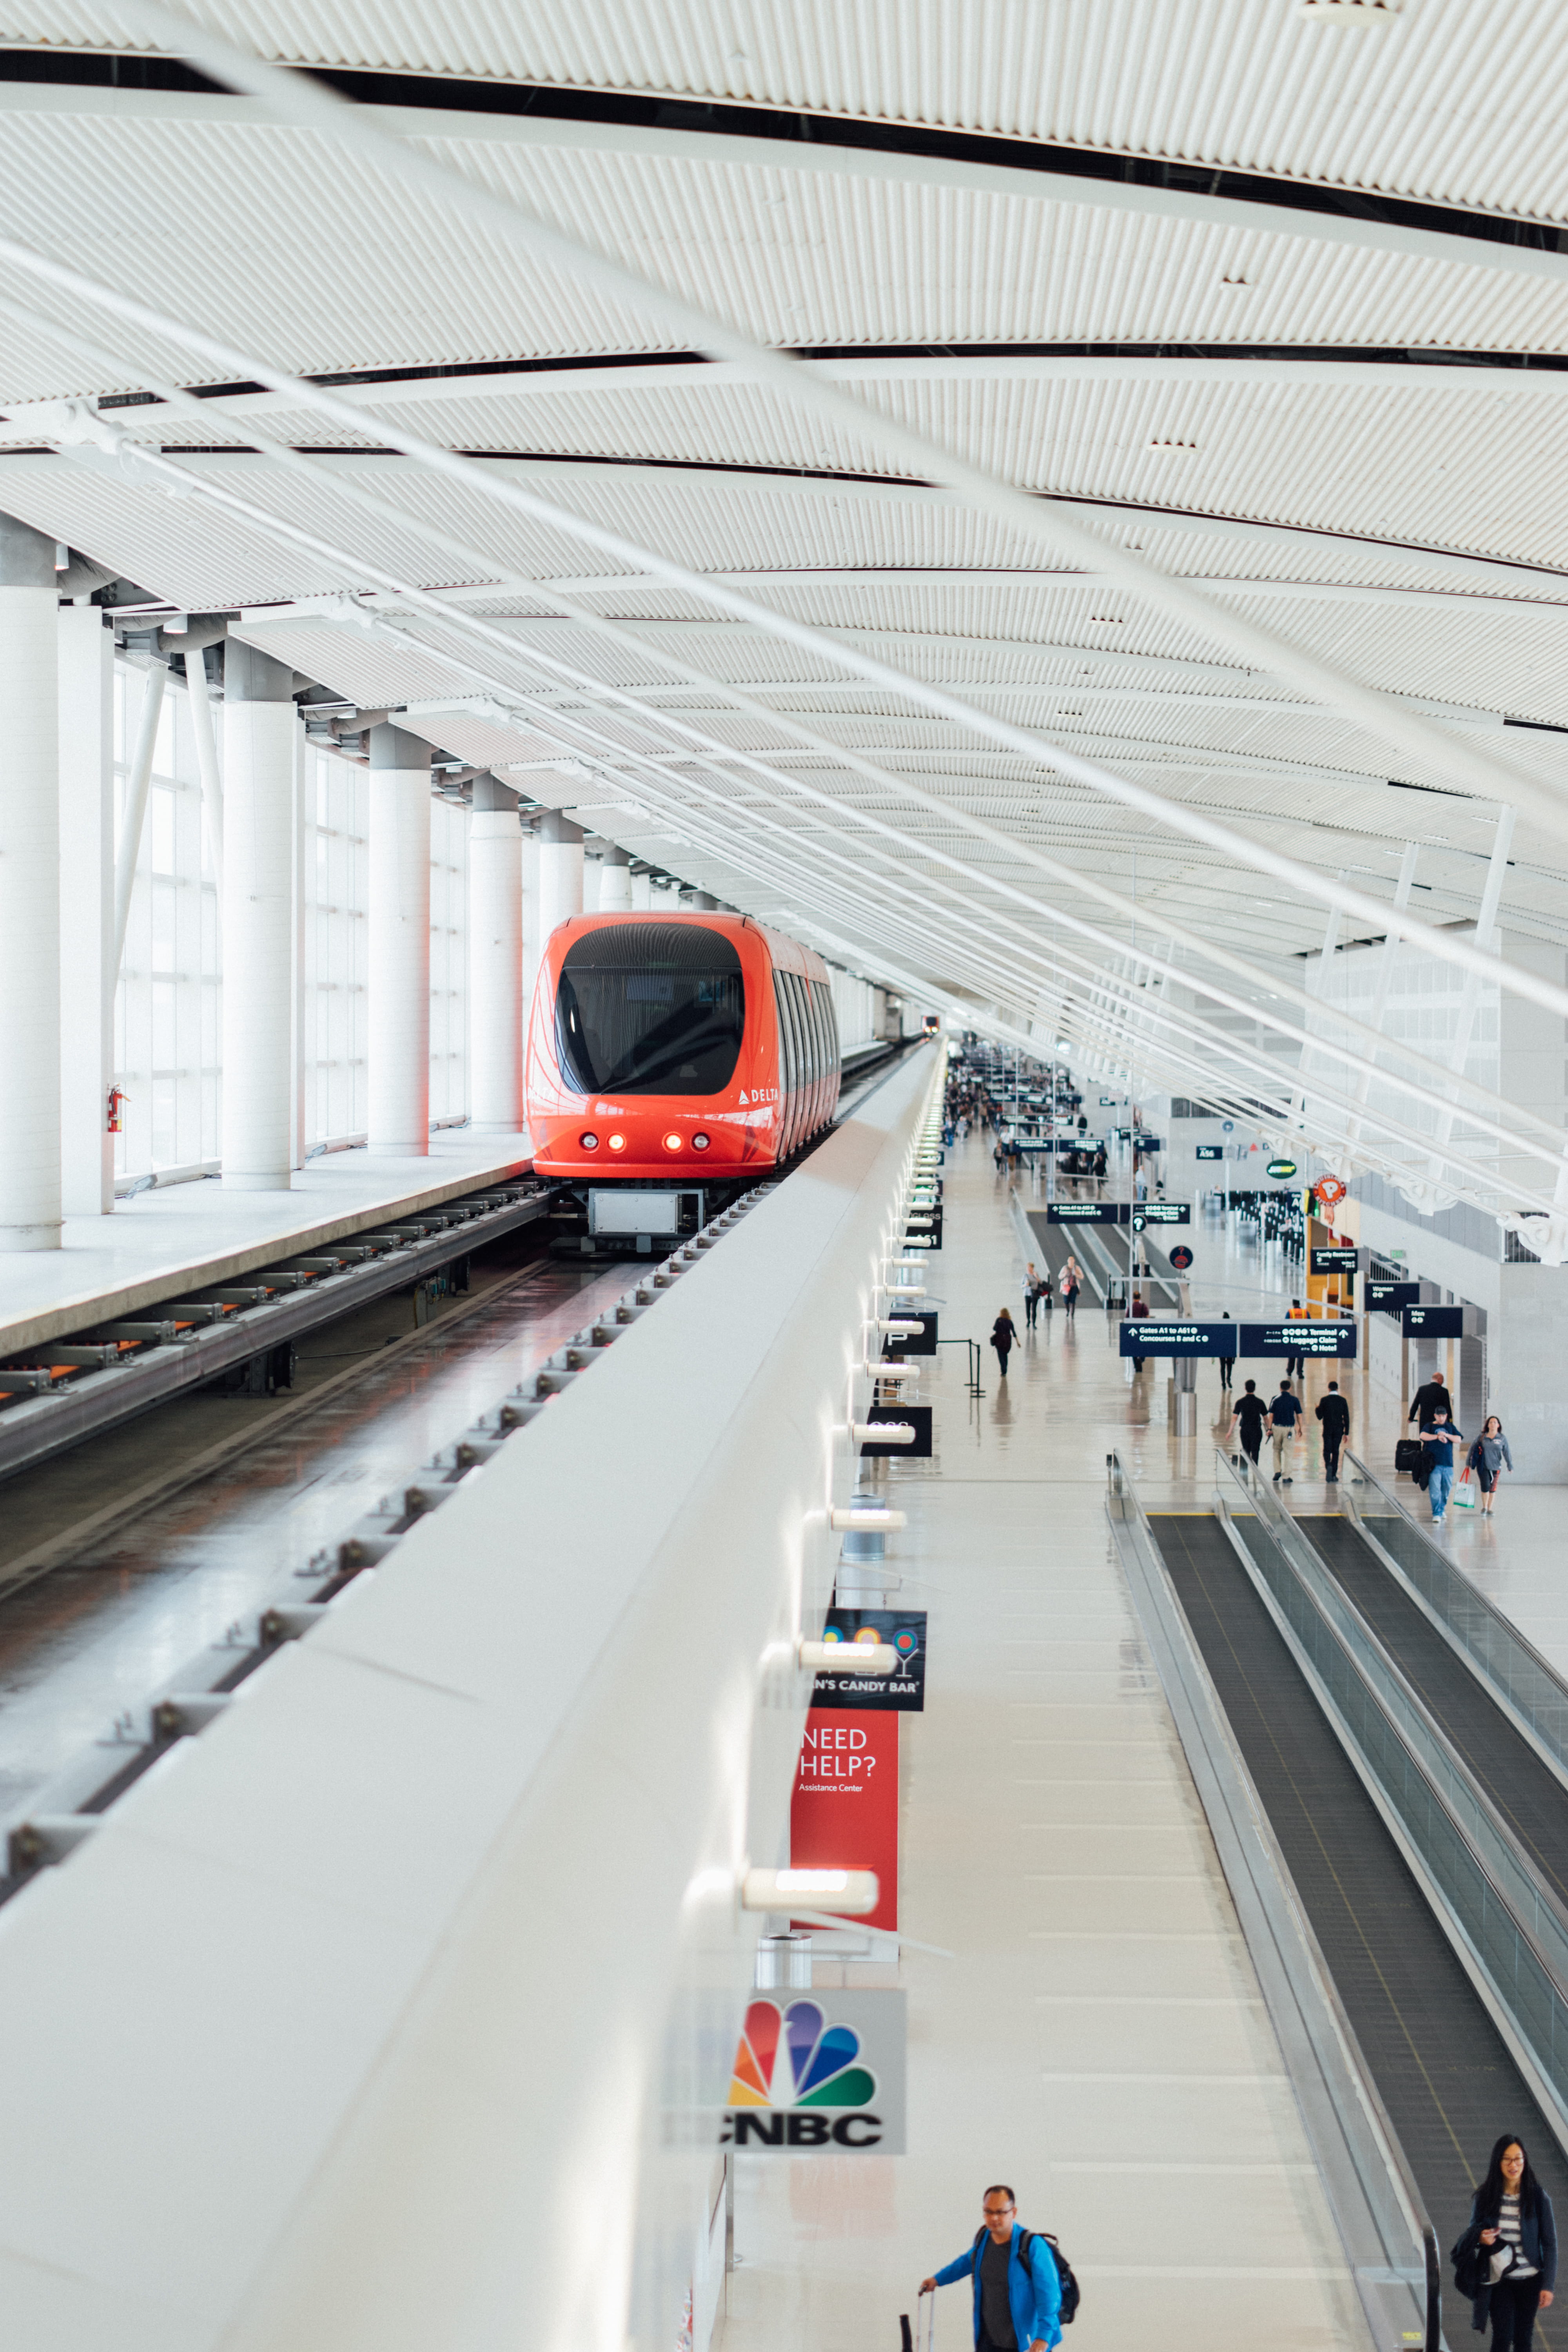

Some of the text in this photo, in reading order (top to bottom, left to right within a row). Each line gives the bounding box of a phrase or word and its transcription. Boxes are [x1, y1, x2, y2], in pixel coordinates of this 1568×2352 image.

[751, 1088, 778, 1102] DELTA
[1290, 1336, 1318, 1345] Luggage
[839, 1681, 886, 1691] CANDY
[801, 1728, 867, 1749] NEED
[800, 1755, 876, 1777] HELP?
[799, 1783, 837, 1791] Assistance
